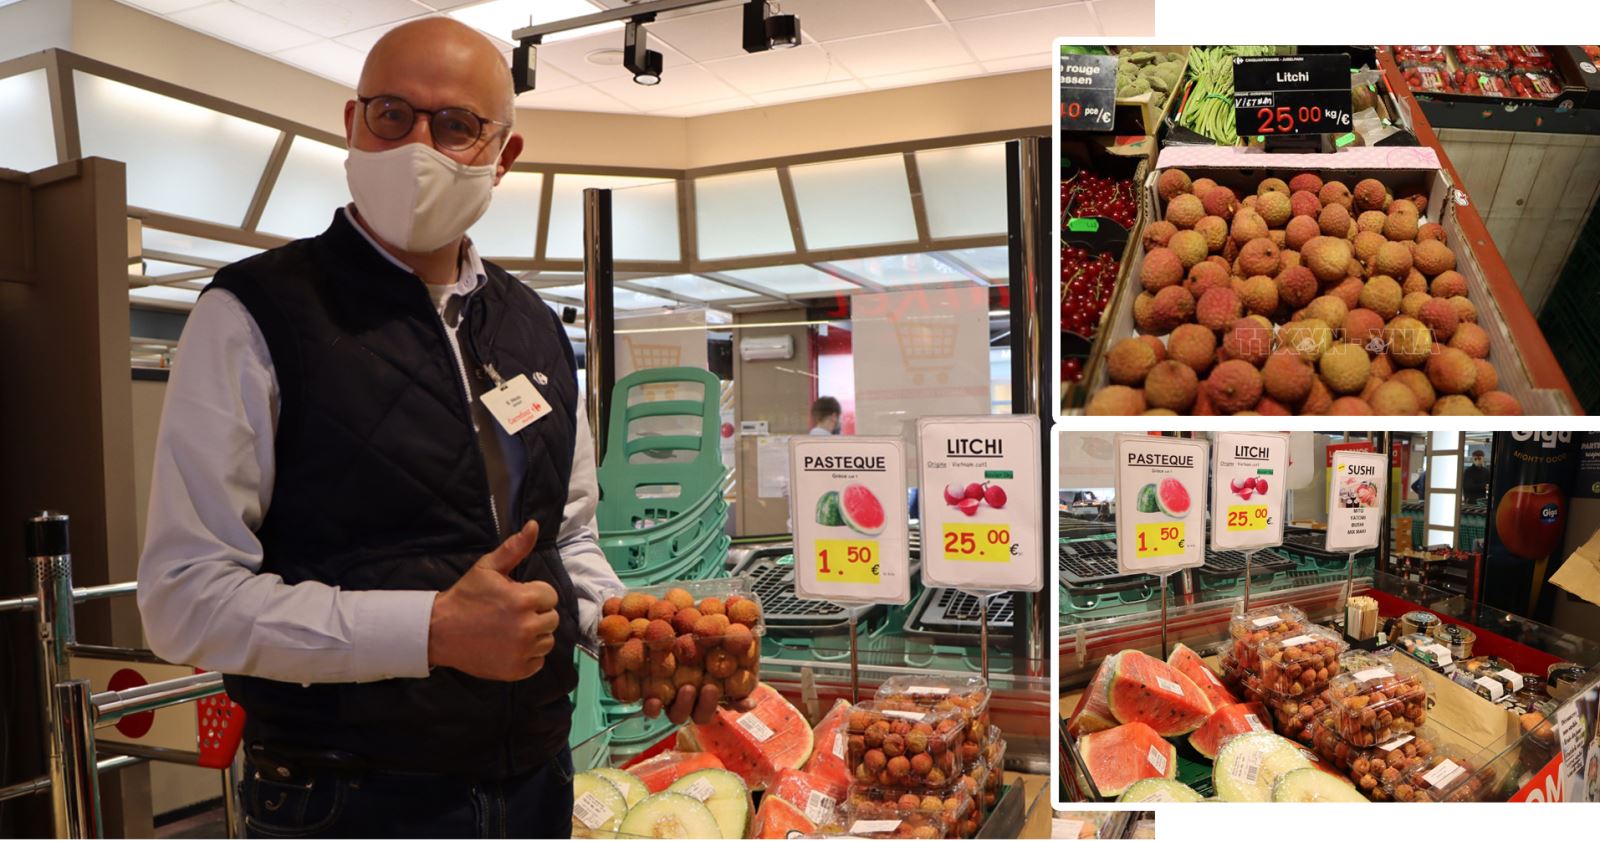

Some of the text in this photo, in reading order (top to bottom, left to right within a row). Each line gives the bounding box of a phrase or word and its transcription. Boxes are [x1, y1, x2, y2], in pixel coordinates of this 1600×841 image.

[1066, 65, 1100, 76] rouge
[1276, 70, 1309, 83] Litchi
[947, 439, 1003, 455] LITCHI
[1235, 445, 1269, 459] LITCHI
[804, 456, 886, 469] PASTEQUE
[1128, 453, 1194, 466] PASTEQUE
[1348, 464, 1375, 476] SUSHI
